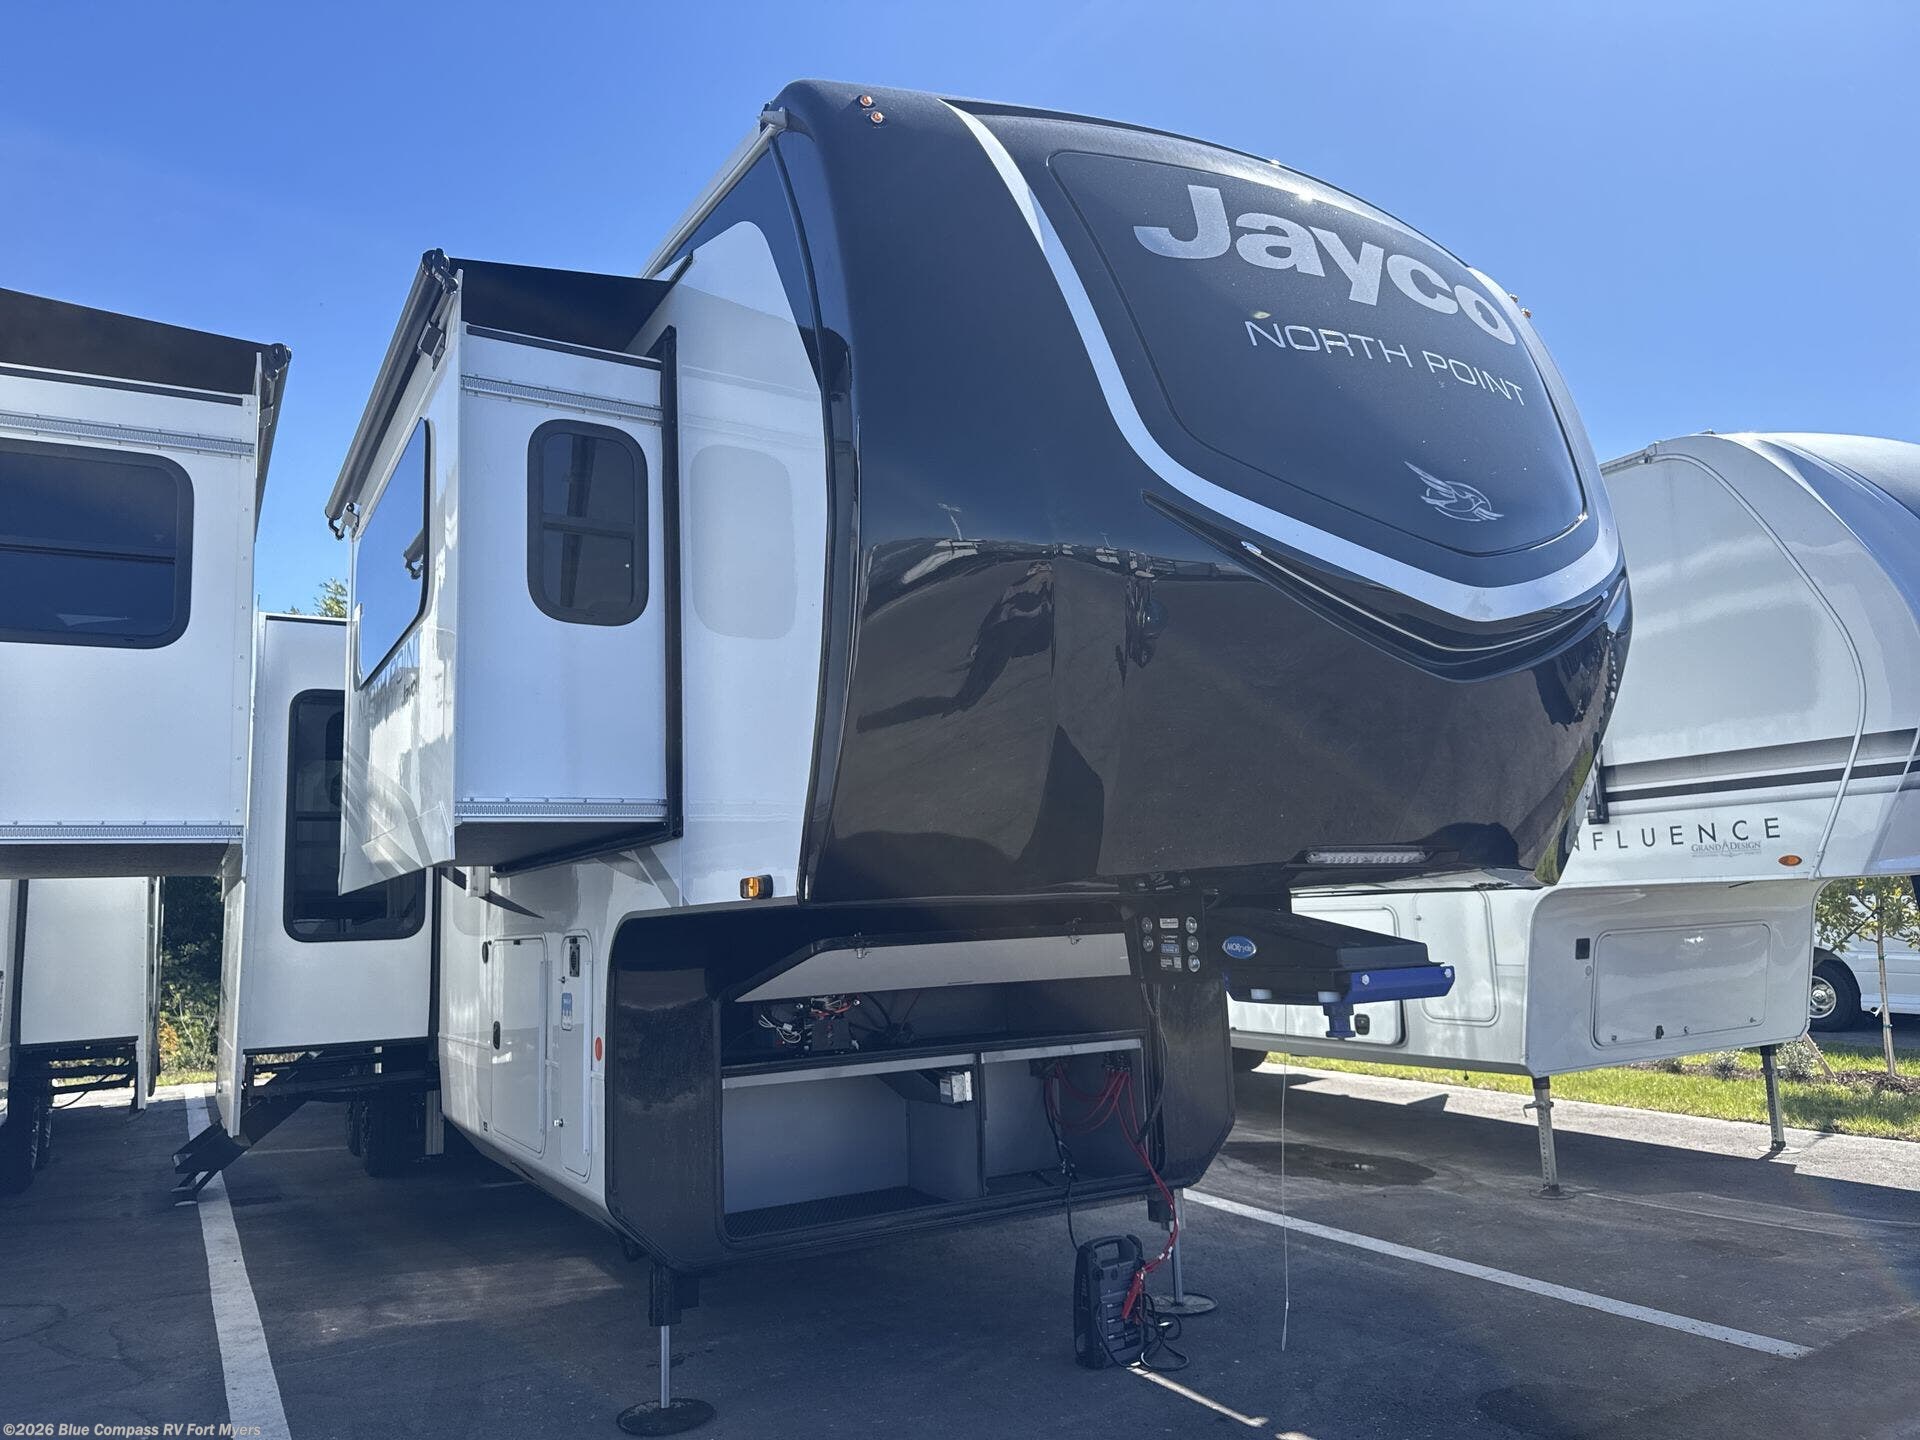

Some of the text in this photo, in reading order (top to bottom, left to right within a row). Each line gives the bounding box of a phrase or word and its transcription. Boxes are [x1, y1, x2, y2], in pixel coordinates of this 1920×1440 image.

[1133, 184, 1516, 345] Jayco
[1244, 320, 1525, 406] NORTH POINT
